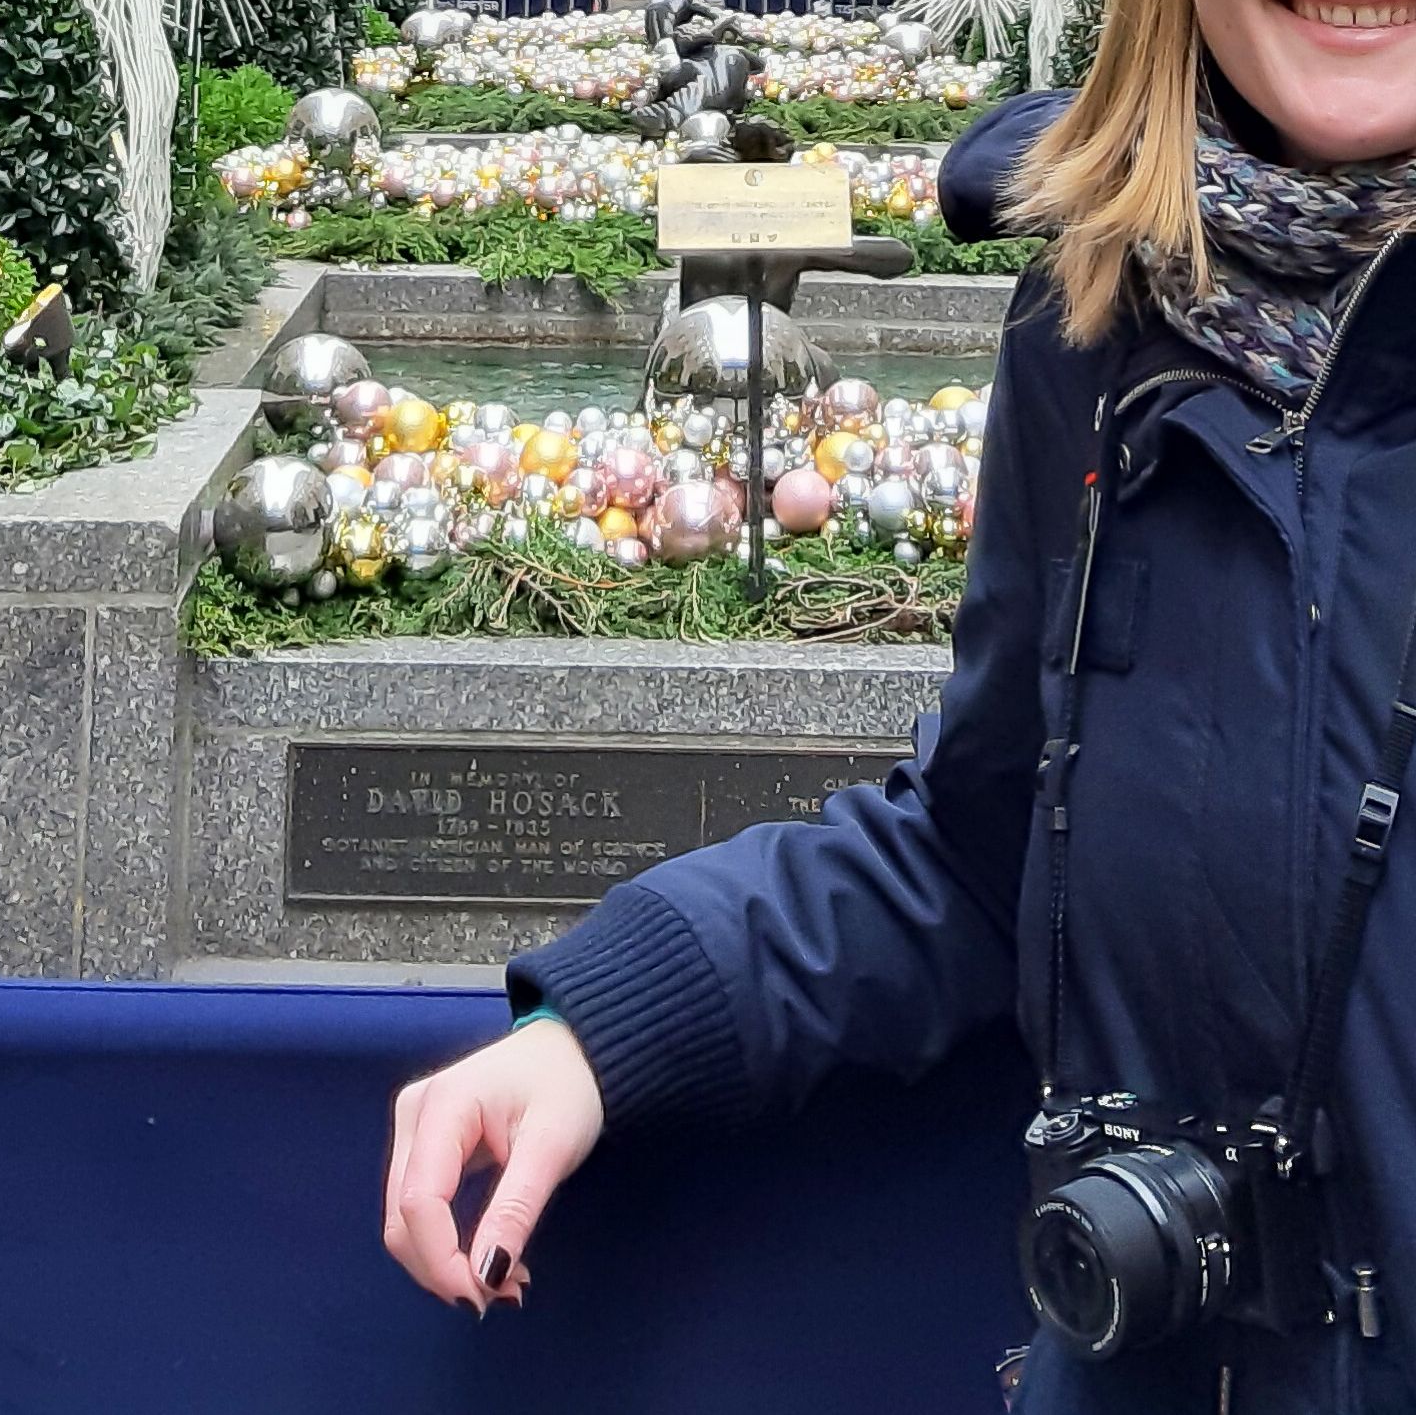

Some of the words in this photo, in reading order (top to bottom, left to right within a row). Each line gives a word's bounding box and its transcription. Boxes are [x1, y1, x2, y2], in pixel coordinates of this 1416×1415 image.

[554, 772, 580, 787] OF
[366, 788, 462, 815] DAVID
[489, 789, 622, 817] HOSACK
[560, 840, 583, 855] OF
[521, 859, 554, 874] THE
